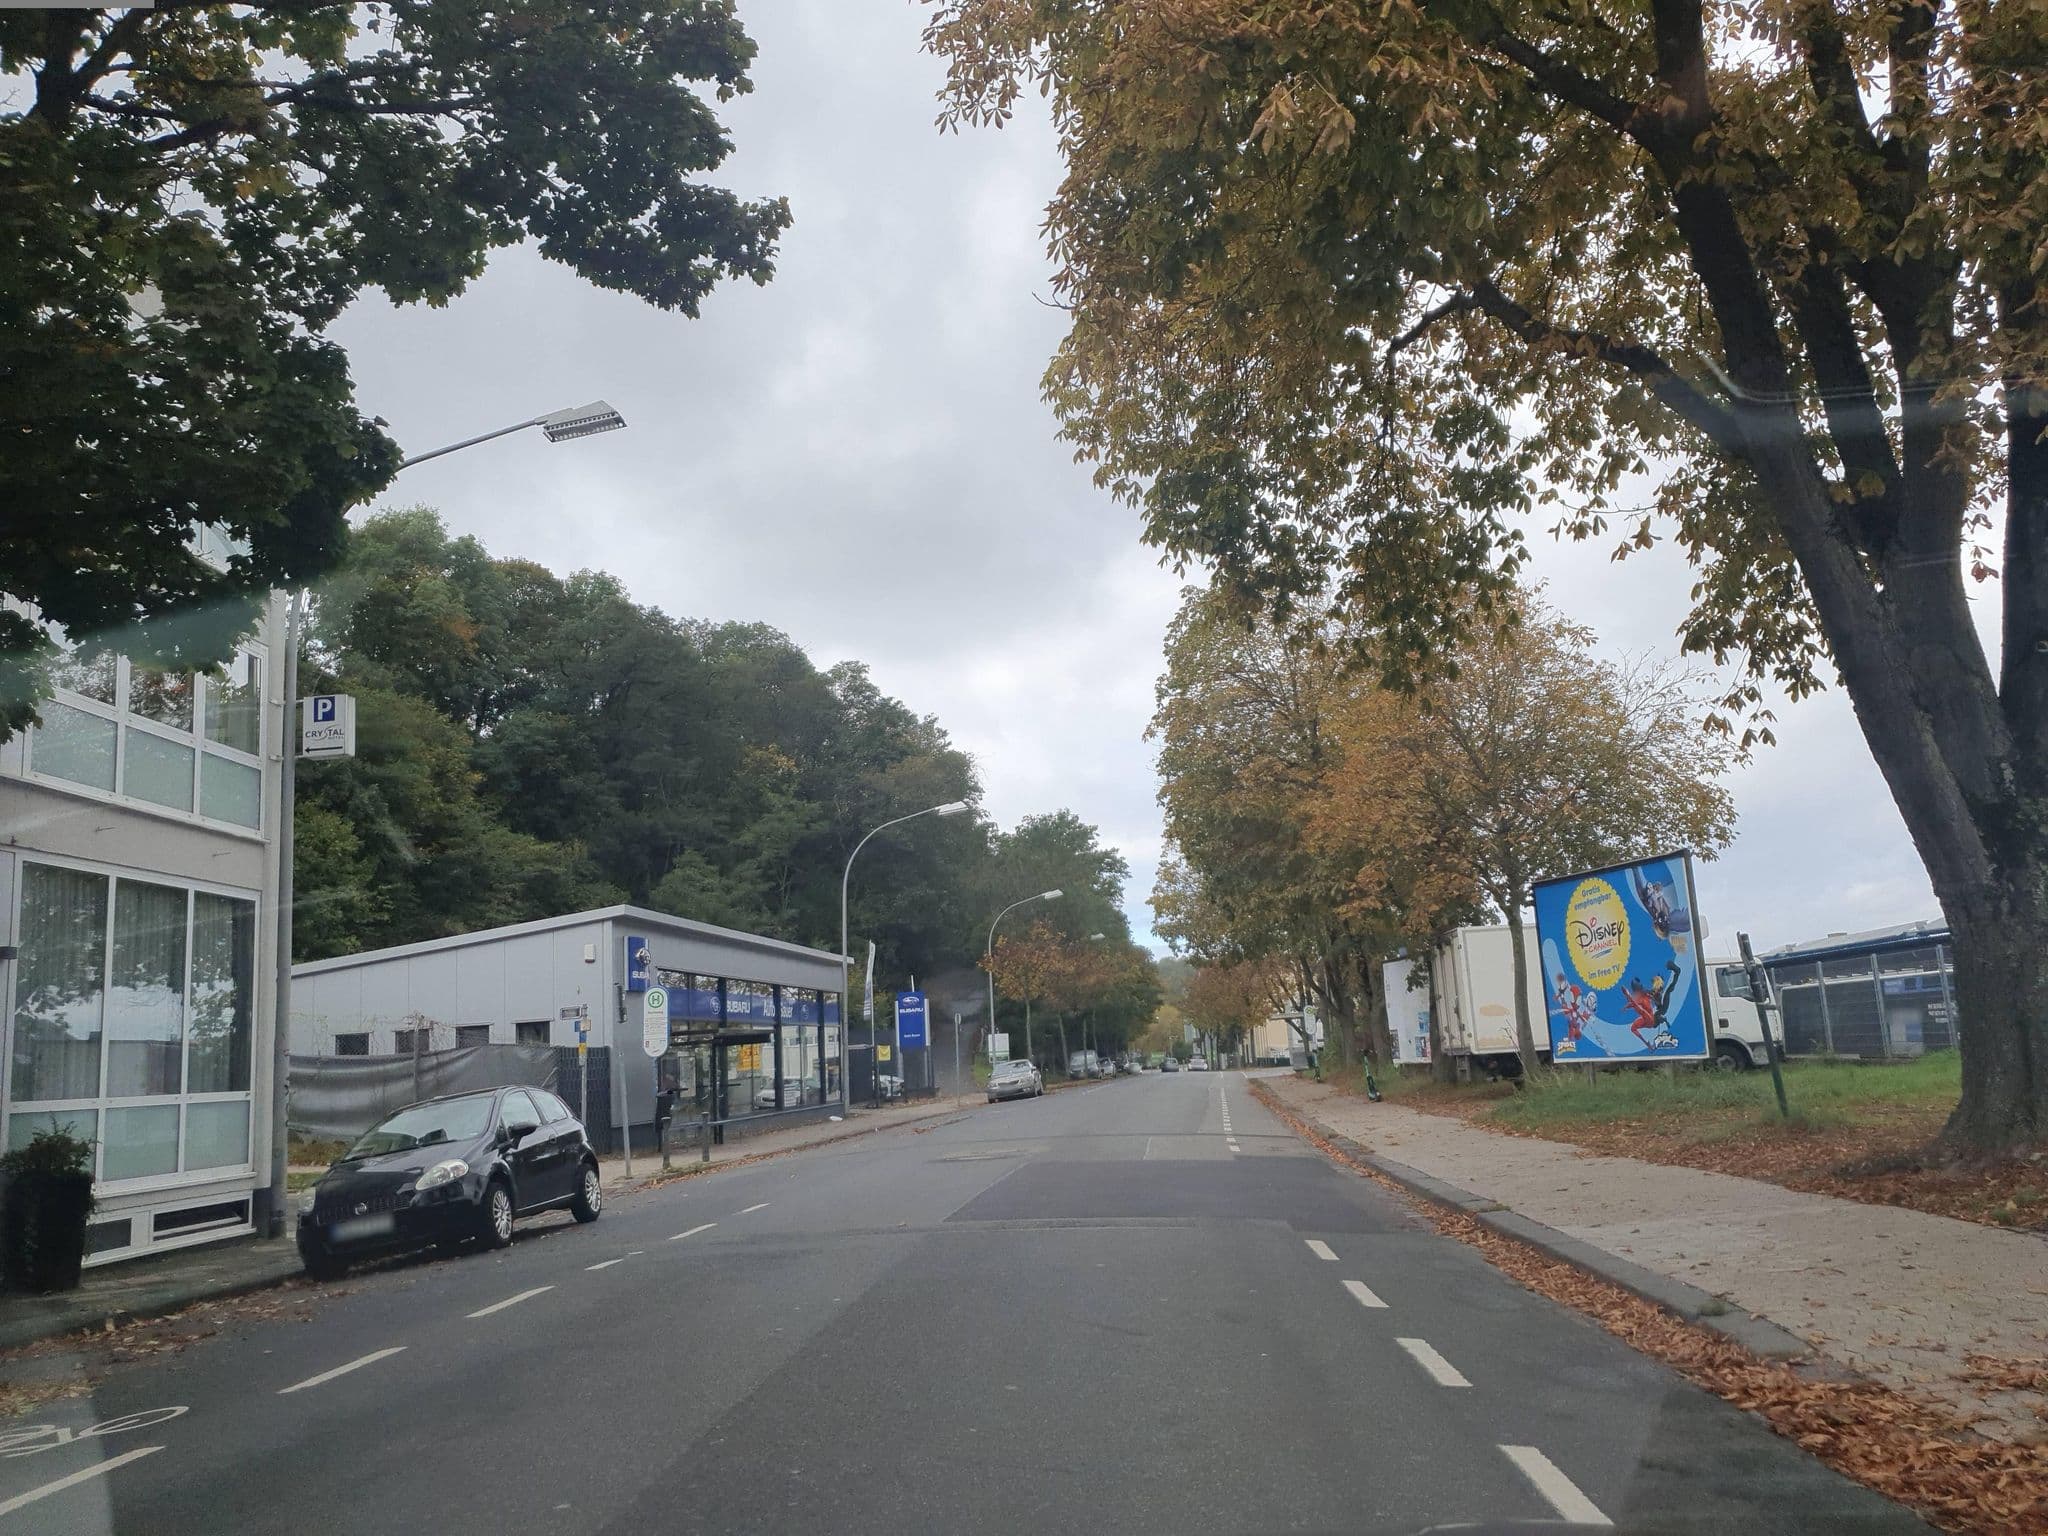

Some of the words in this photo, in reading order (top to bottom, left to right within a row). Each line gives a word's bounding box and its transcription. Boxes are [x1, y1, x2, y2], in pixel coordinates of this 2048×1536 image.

[318, 699, 332, 720] P
[305, 726, 344, 740] CRYSTAL
[1581, 885, 1600, 897] Gratis
[1574, 892, 1611, 910] empfangbar
[1588, 940, 1618, 953] CHANNEL
[1612, 964, 1620, 973] TV
[726, 1000, 751, 1014] SUBARU
